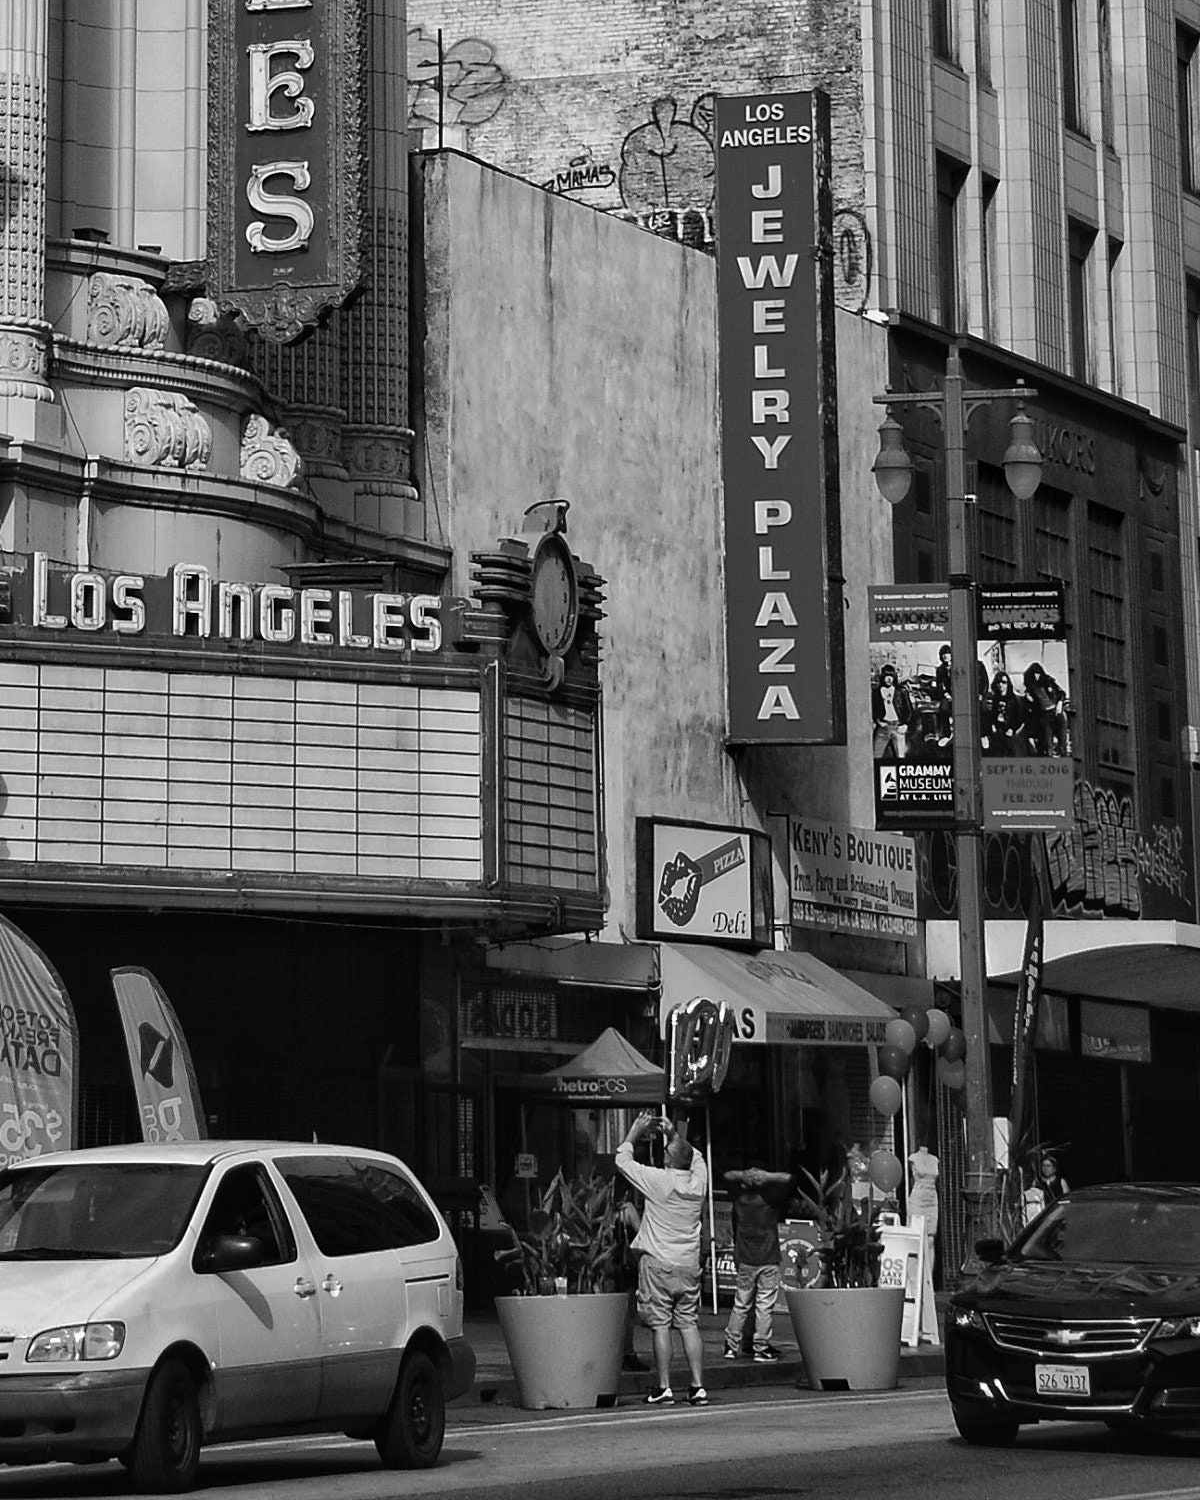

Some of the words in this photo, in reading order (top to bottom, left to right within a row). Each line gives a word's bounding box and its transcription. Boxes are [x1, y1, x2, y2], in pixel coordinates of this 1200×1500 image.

[746, 104, 785, 123] LOS
[720, 126, 811, 148] ANGELES
[736, 166, 799, 470] JEWELRY
[33, 552, 145, 634] LOS
[754, 501, 801, 720] PLAZA
[875, 612, 949, 624] RAMONES
[899, 765, 952, 777] GRAMMY
[899, 778, 954, 790] MUSEUM
[793, 822, 841, 859] KENY'S
[847, 833, 913, 871] BOUTIQUE
[712, 847, 744, 874] PIZZA
[712, 910, 746, 934] Deli
[1039, 1373, 1058, 1388] S26
[1063, 1374, 1086, 1390] 9137
